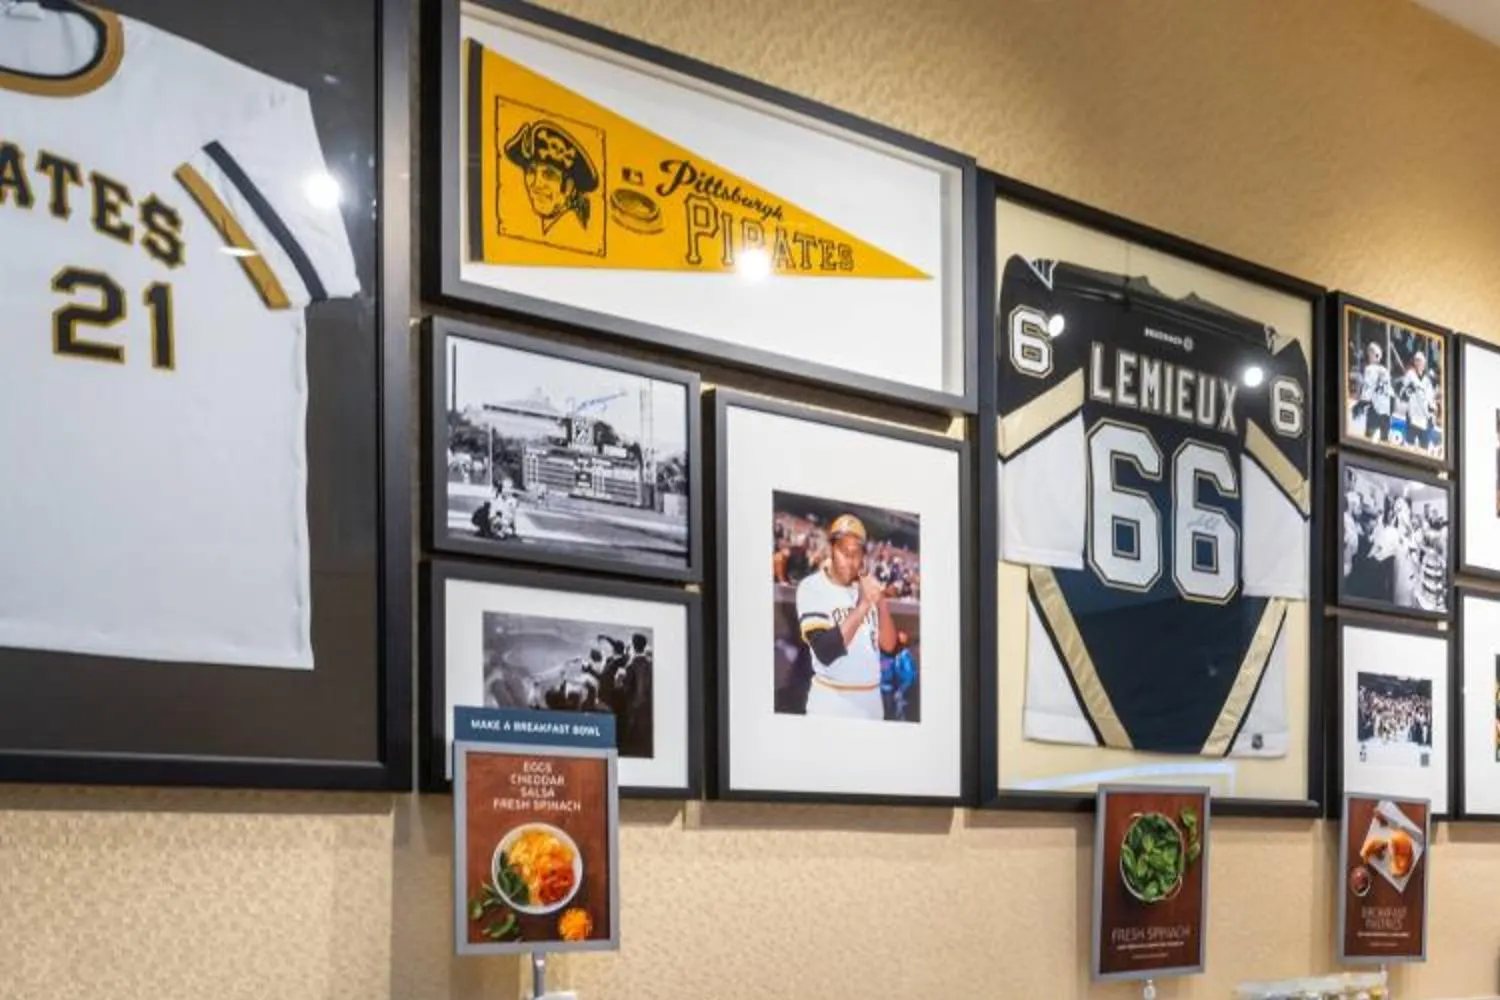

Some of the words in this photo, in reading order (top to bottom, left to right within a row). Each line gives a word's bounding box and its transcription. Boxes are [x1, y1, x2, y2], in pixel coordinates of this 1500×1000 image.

[656, 159, 784, 221] Pittsburgh
[684, 193, 855, 272] PIRATES
[51, 266, 175, 371] 21
[1089, 342, 1238, 433] LEMIEUX
[1087, 418, 1240, 606] 66
[471, 719, 500, 731] MAKE
[503, 721, 511, 731] A
[513, 721, 569, 735] BREAKFAST
[572, 724, 601, 737] BOWL
[510, 774, 565, 785] CHEDDAR
[523, 761, 553, 773] EGGS
[493, 798, 531, 810] FRESH
[533, 800, 581, 812] SPINACH
[520, 786, 555, 798] SALSA
